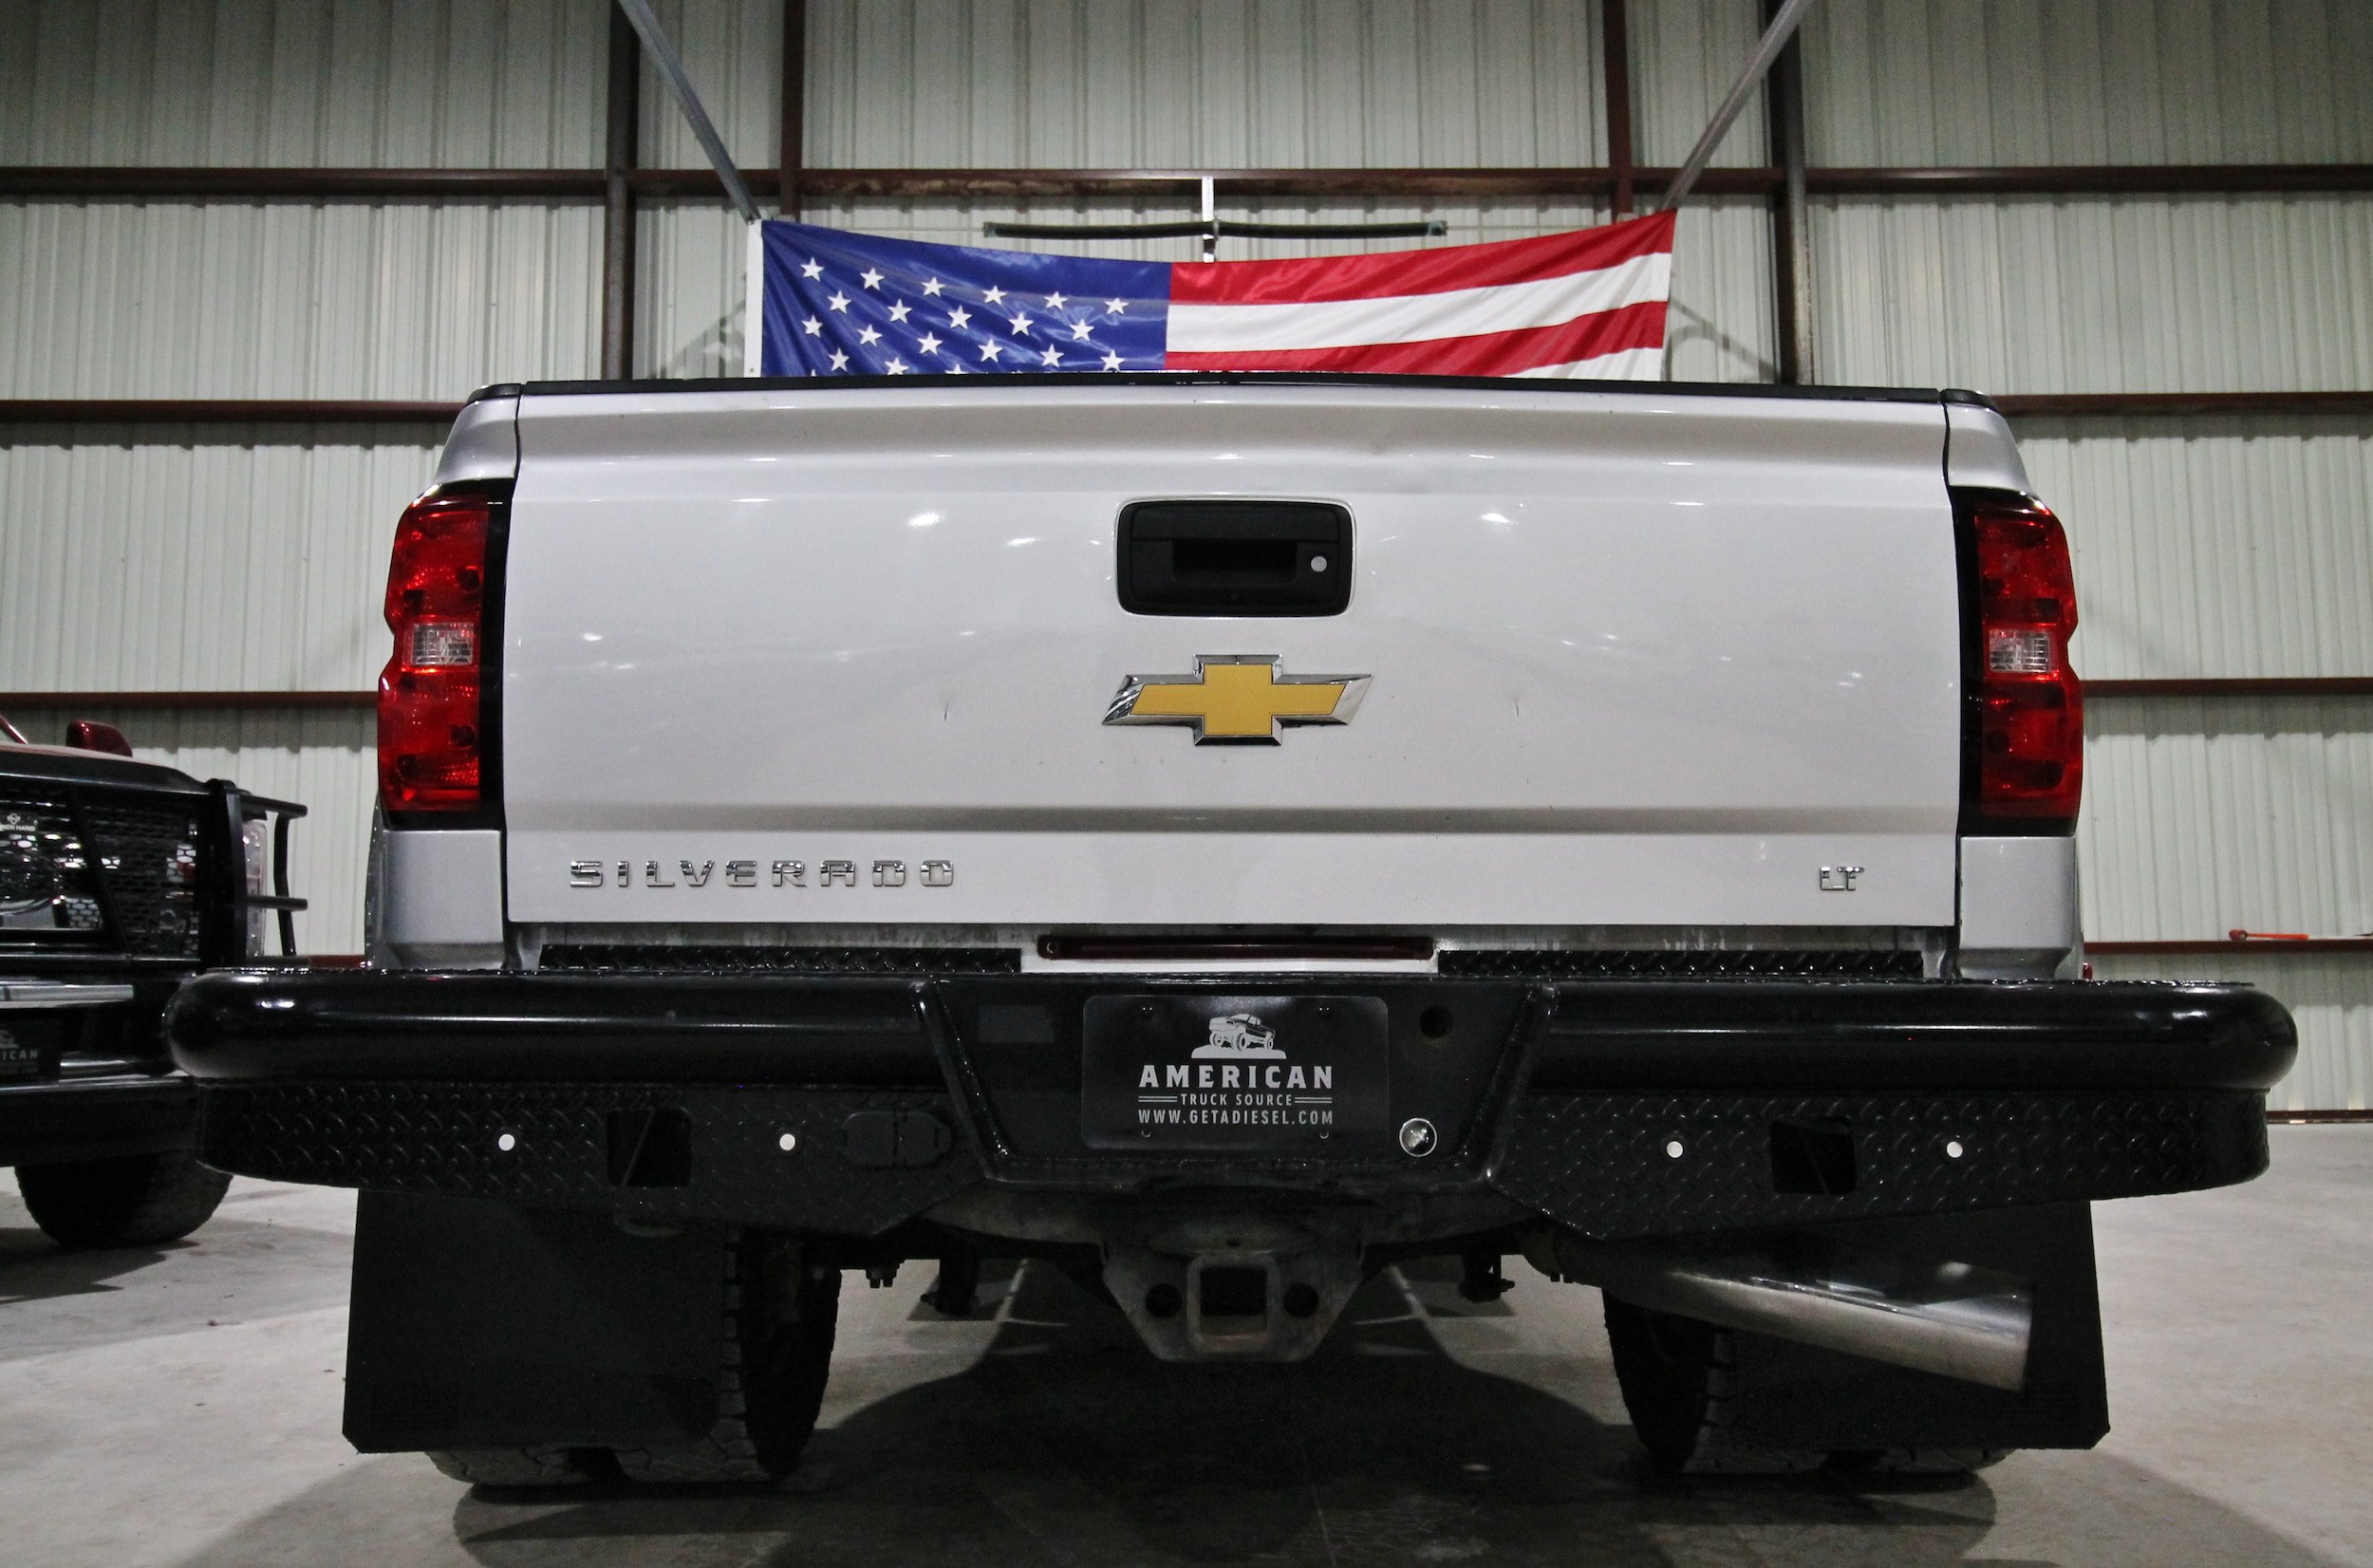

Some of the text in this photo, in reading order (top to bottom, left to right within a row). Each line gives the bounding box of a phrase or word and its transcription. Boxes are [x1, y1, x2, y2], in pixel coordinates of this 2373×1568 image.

[570, 860, 954, 887] SILVERADO
[1820, 867, 1865, 891] LT
[1139, 1065, 1333, 1089] AMERICAN
[1181, 1093, 1293, 1107] TRUCK SOURCE
[1138, 1110, 1333, 1125] WWW.GETADIESEL.COM
